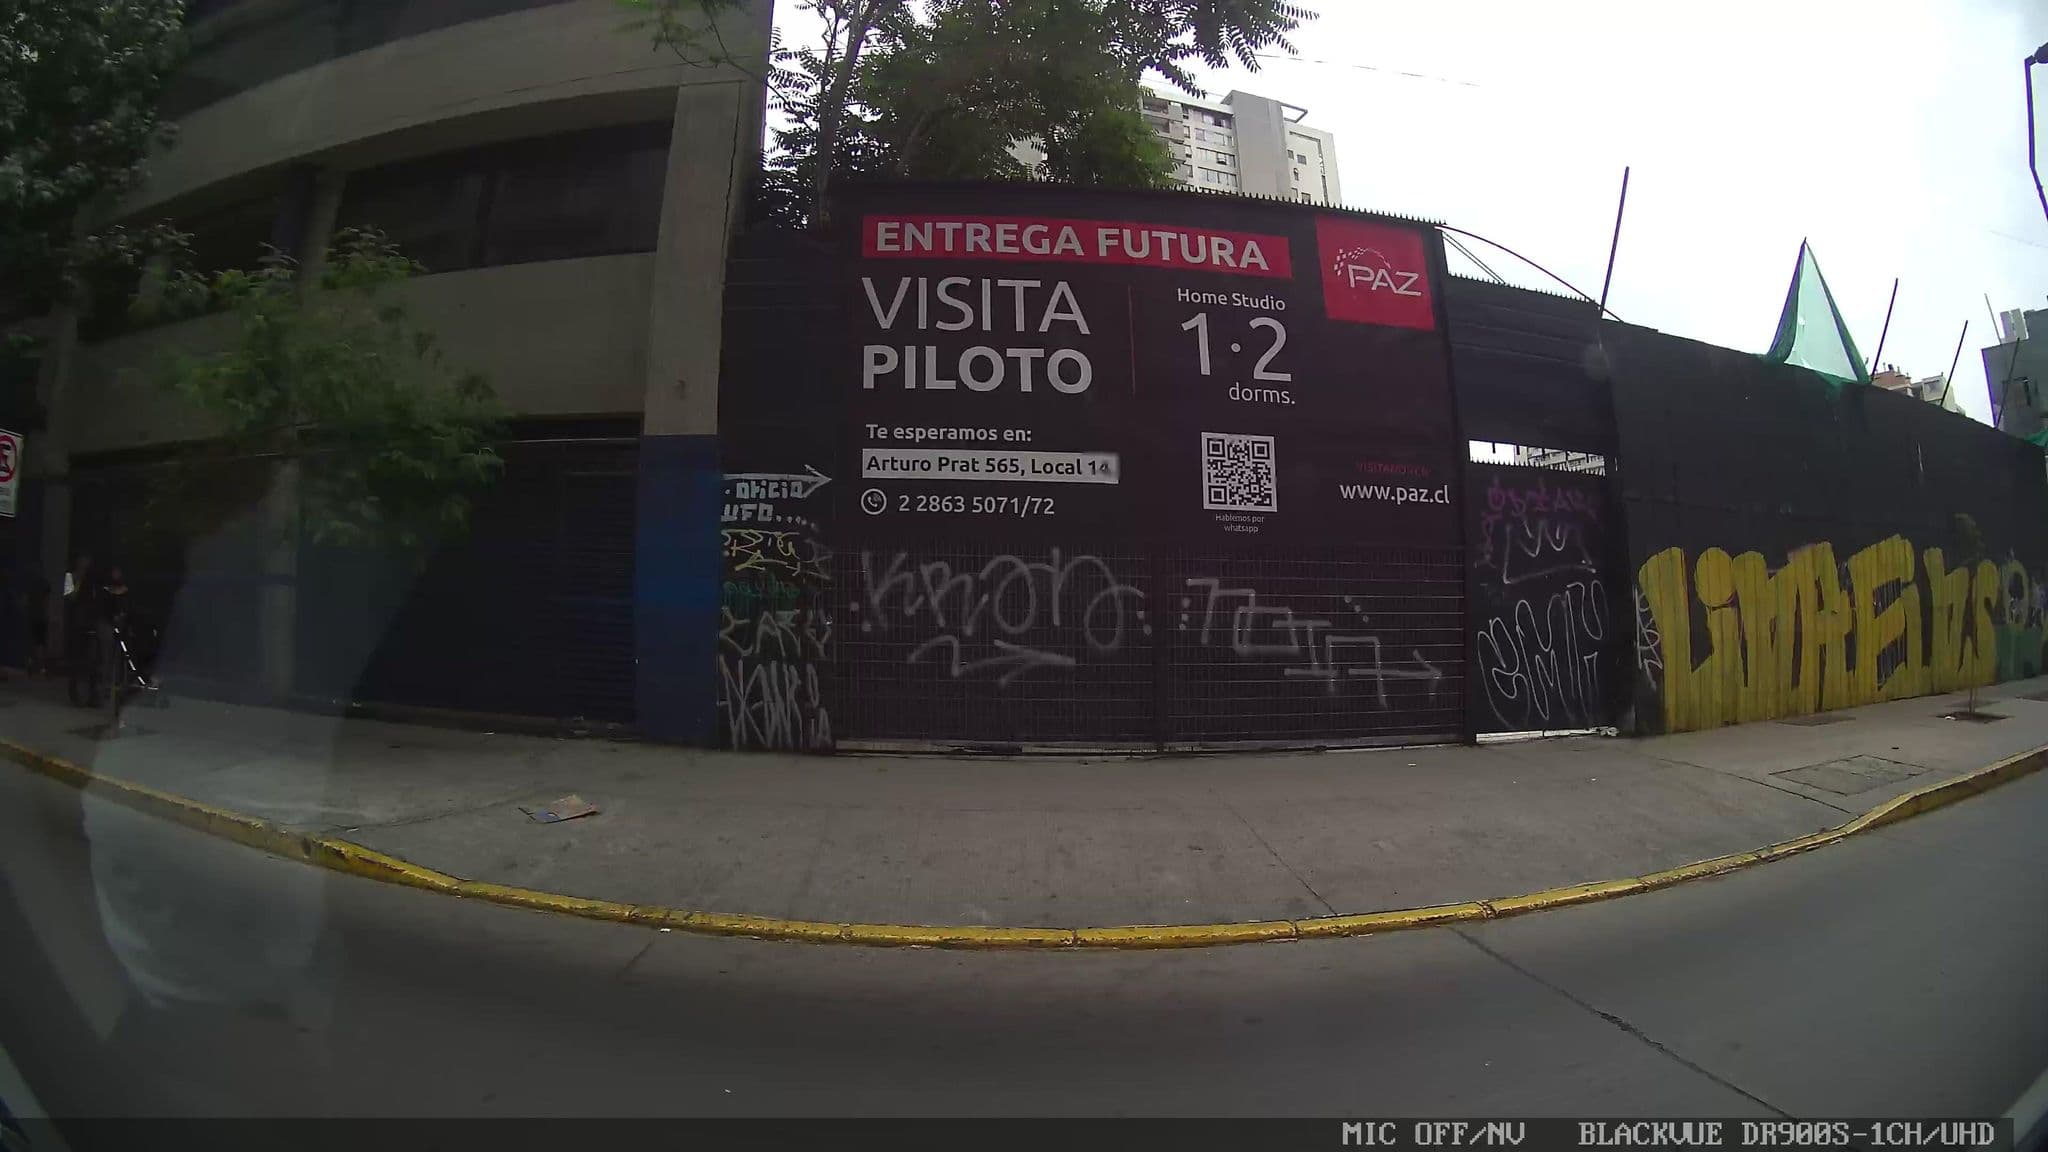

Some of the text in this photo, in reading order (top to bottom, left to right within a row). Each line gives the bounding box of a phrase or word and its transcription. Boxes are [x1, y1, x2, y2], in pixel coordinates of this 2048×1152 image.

[877, 222, 1269, 271] ENTREGA FUTURA
[1347, 263, 1422, 297] PAZ
[861, 276, 1091, 335] VISITA
[1176, 287, 1286, 312] Home Studio
[863, 345, 1093, 394] PILOTO
[1228, 382, 1296, 405] dorms.
[866, 423, 1032, 443] Te esperamos en:
[866, 456, 931, 472] Arturo
[938, 457, 980, 473] Prat
[985, 457, 1026, 477] 565,
[1031, 458, 1082, 475] Local
[899, 495, 1055, 517] 2 2863 5071/72
[1339, 485, 1450, 505] www.paz.cl
[1215, 513, 1265, 525] Hablemos por
[1223, 523, 1259, 534] whatsapp
